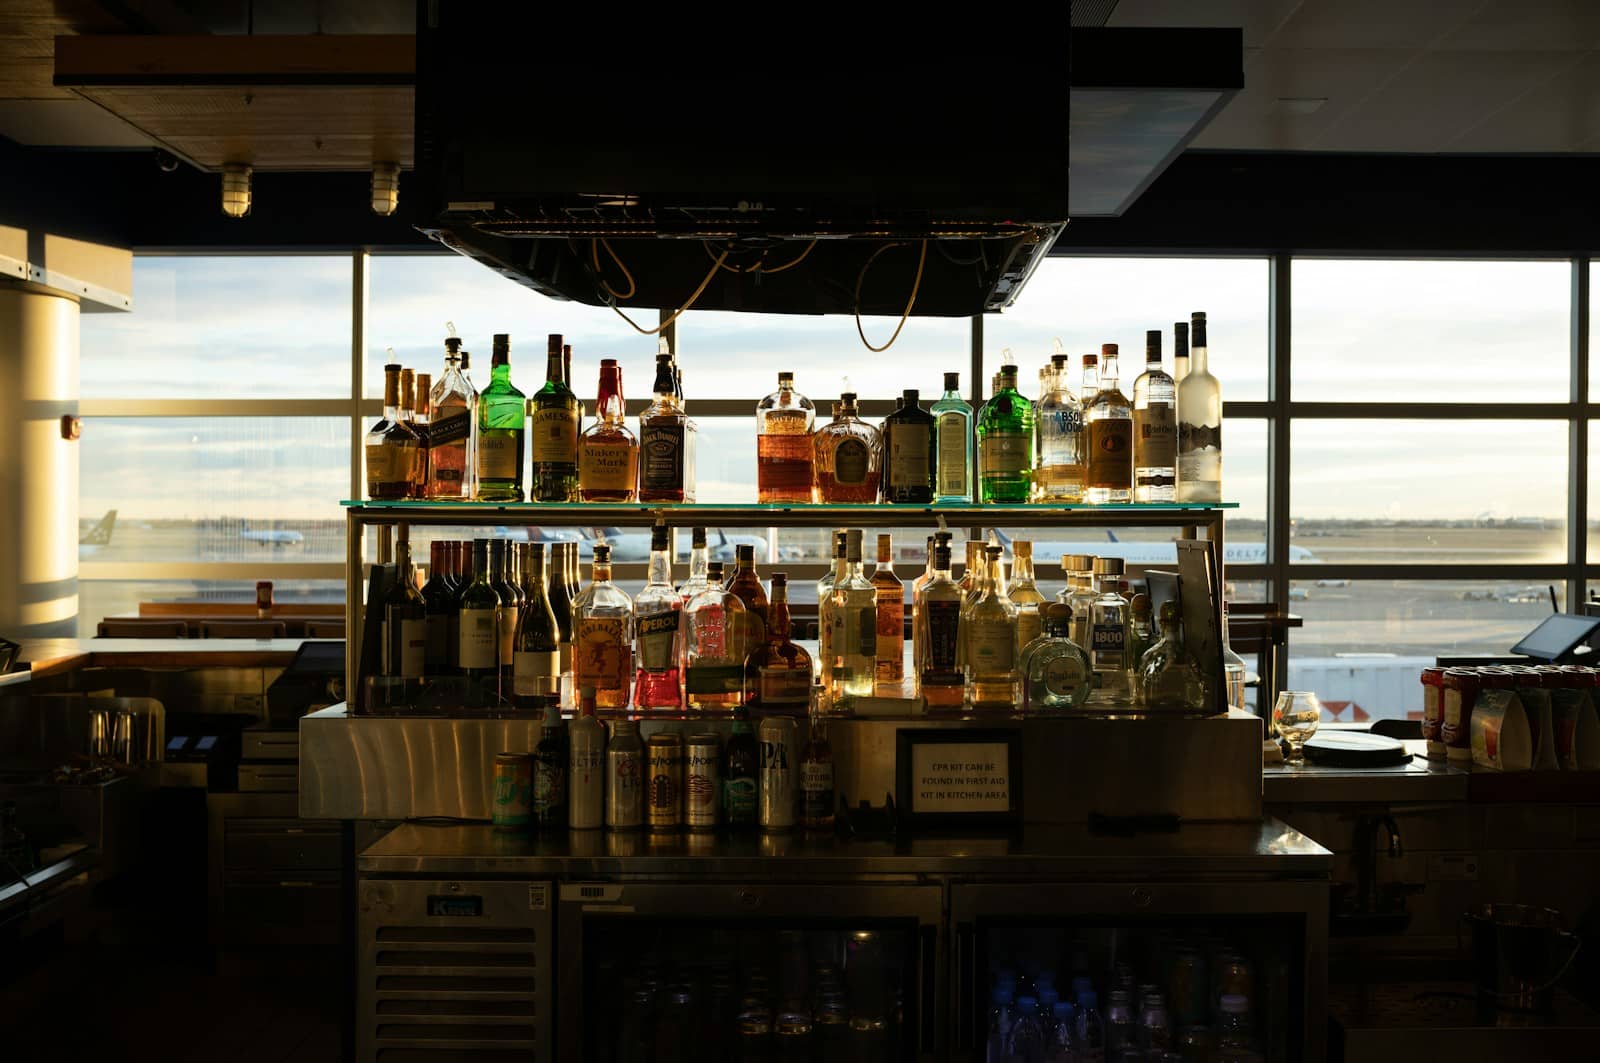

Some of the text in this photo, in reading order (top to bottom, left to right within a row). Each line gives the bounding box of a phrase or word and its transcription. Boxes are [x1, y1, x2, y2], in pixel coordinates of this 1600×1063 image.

[585, 448, 628, 457] Maker's
[638, 616, 677, 633] APEROL
[1094, 631, 1123, 645] 1800
[932, 763, 996, 772] CPR KIT CAN BE
[922, 777, 1005, 785] FOUND IN FIRST AID
[921, 792, 1008, 800] KIT IN KITCHEN AREA
